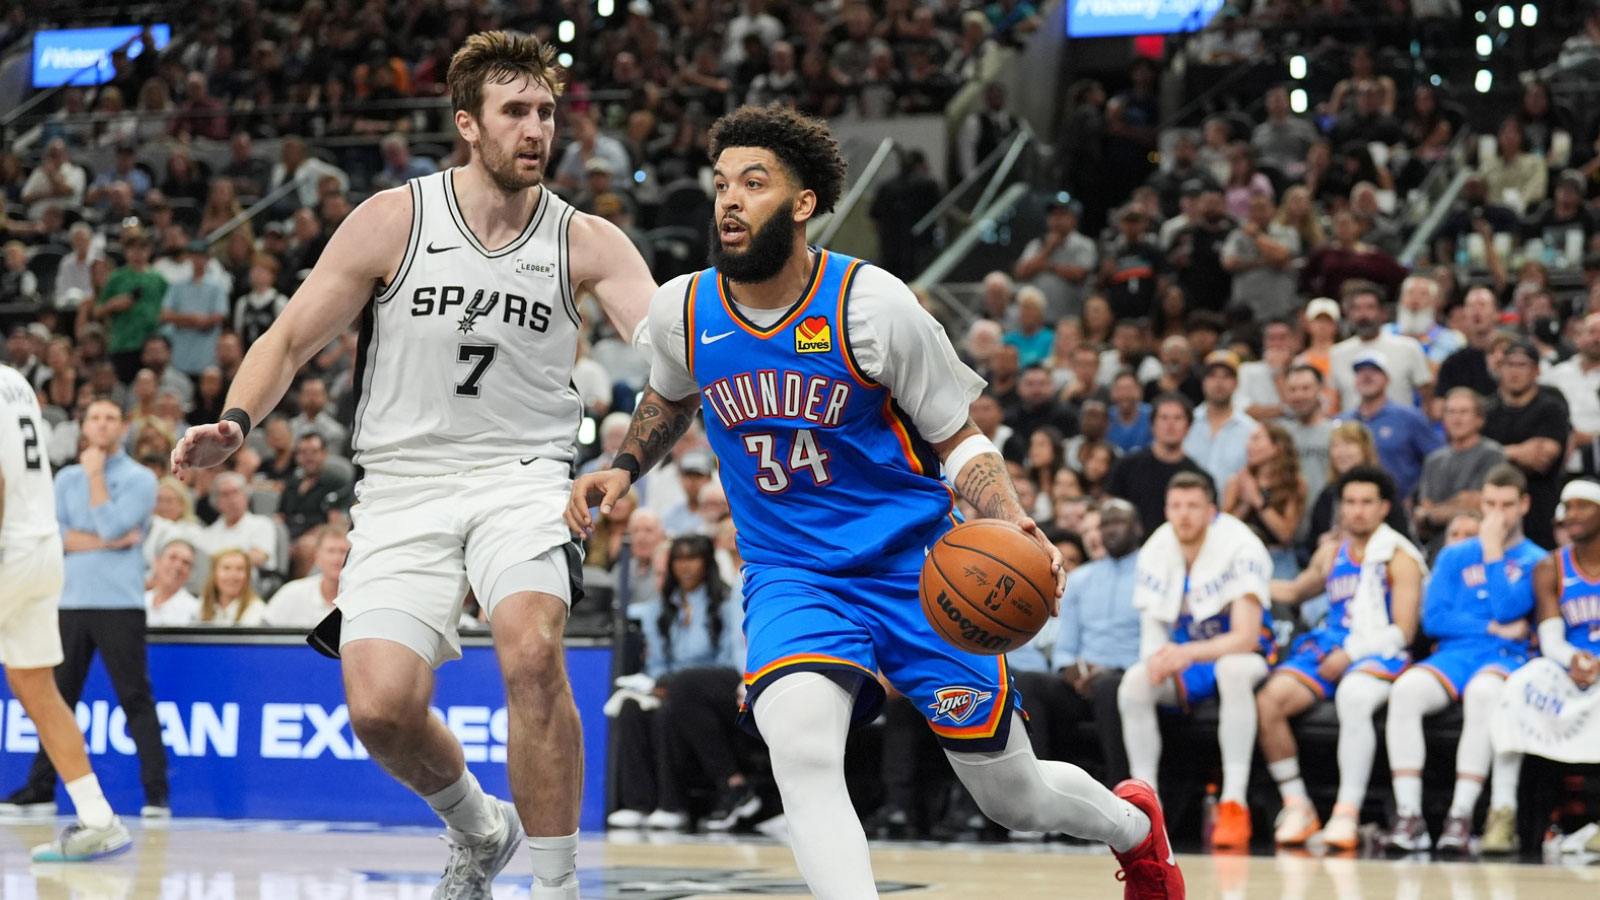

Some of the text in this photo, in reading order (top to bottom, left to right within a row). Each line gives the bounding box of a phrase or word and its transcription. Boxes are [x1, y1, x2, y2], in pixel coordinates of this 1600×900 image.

[521, 263, 550, 273] LEDGER
[411, 286, 552, 334] SPURS
[453, 342, 499, 398] 7
[702, 369, 851, 430] THUNDER
[19, 415, 41, 471] 2
[740, 428, 833, 495] 34
[936, 589, 1012, 650] Wilson
[938, 694, 970, 714] OKC
